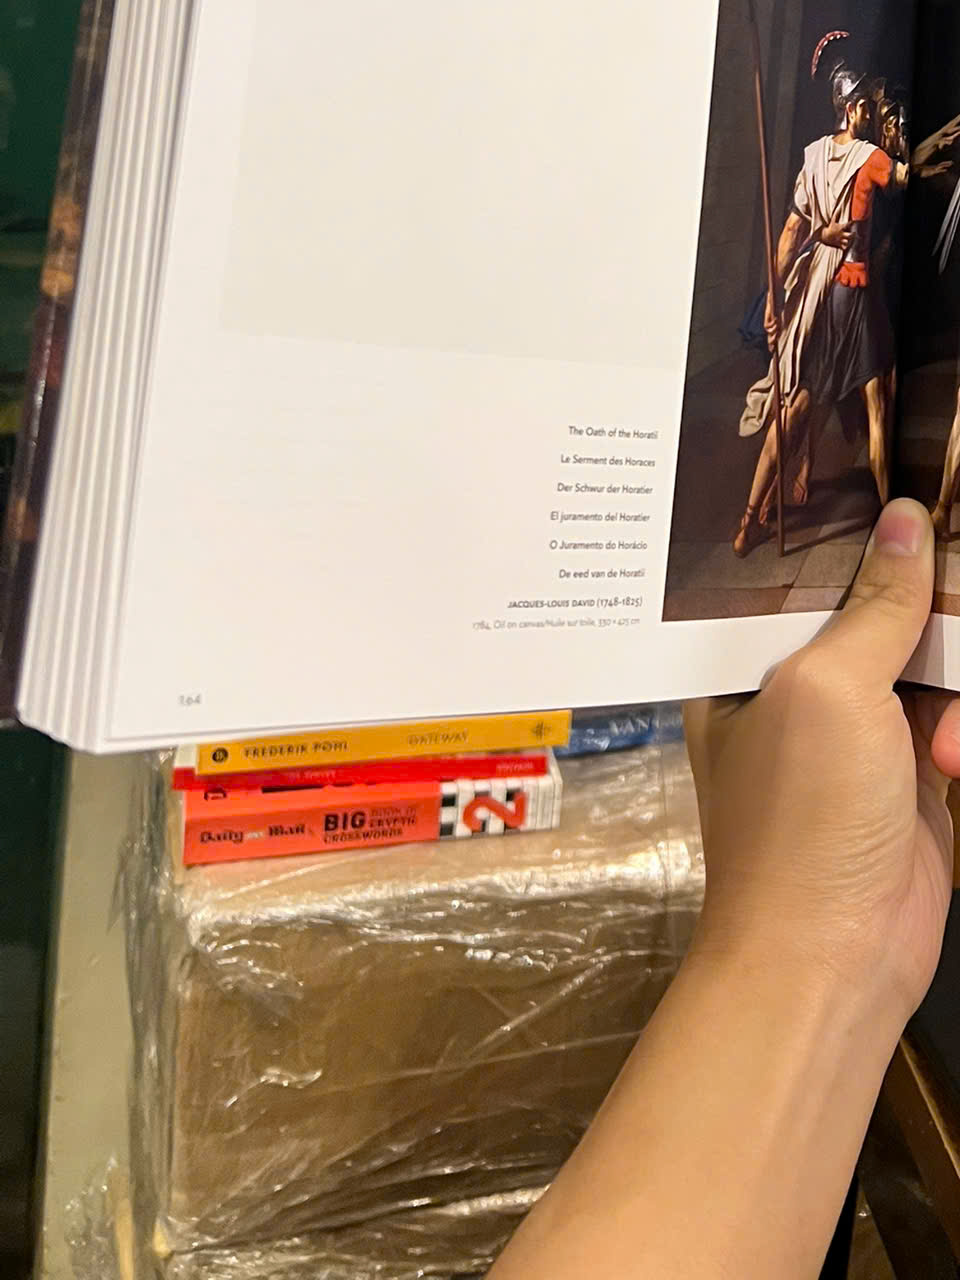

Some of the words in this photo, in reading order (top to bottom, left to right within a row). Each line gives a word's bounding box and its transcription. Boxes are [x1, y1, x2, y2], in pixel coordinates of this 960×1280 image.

[569, 425, 584, 436] The
[586, 426, 606, 437] Oath
[608, 427, 617, 438] of
[618, 428, 631, 439] the
[633, 429, 658, 440] Horatii
[561, 453, 570, 464] Le
[573, 453, 607, 465] Serment
[609, 455, 623, 466] des
[625, 456, 655, 468] Horaces
[557, 481, 573, 493] Der
[575, 482, 605, 494] Schwur
[607, 483, 620, 494] der
[622, 484, 653, 495] Horatier
[550, 510, 559, 521] El
[560, 511, 603, 524] juramento
[605, 511, 618, 522] del
[619, 512, 650, 522] Horatier
[549, 539, 558, 551] O
[559, 539, 603, 550] Juramento
[605, 539, 616, 550] do
[559, 568, 571, 579] De
[573, 568, 589, 579] eed
[591, 570, 605, 579] van
[607, 568, 618, 579] de
[620, 568, 645, 578] Horatii
[324, 811, 366, 832] BIG
[200, 830, 244, 844] Daily
[268, 823, 305, 837] Mail
